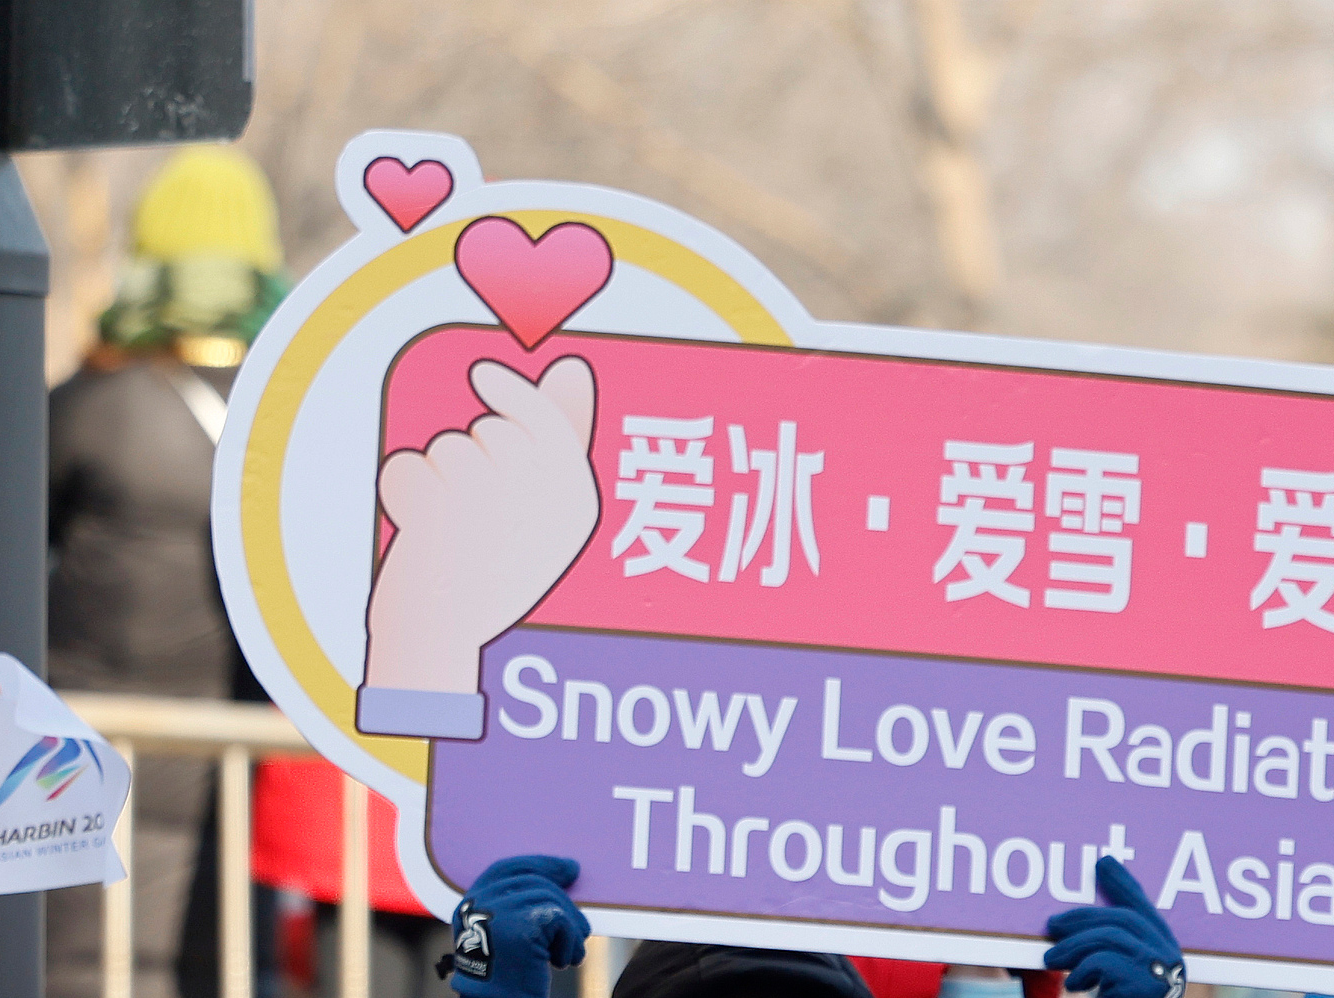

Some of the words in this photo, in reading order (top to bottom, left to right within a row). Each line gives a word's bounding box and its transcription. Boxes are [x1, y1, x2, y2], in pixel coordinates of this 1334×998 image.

[498, 654, 799, 778] Snowy
[820, 676, 1037, 775] Love
[612, 785, 1136, 912] Throughout
